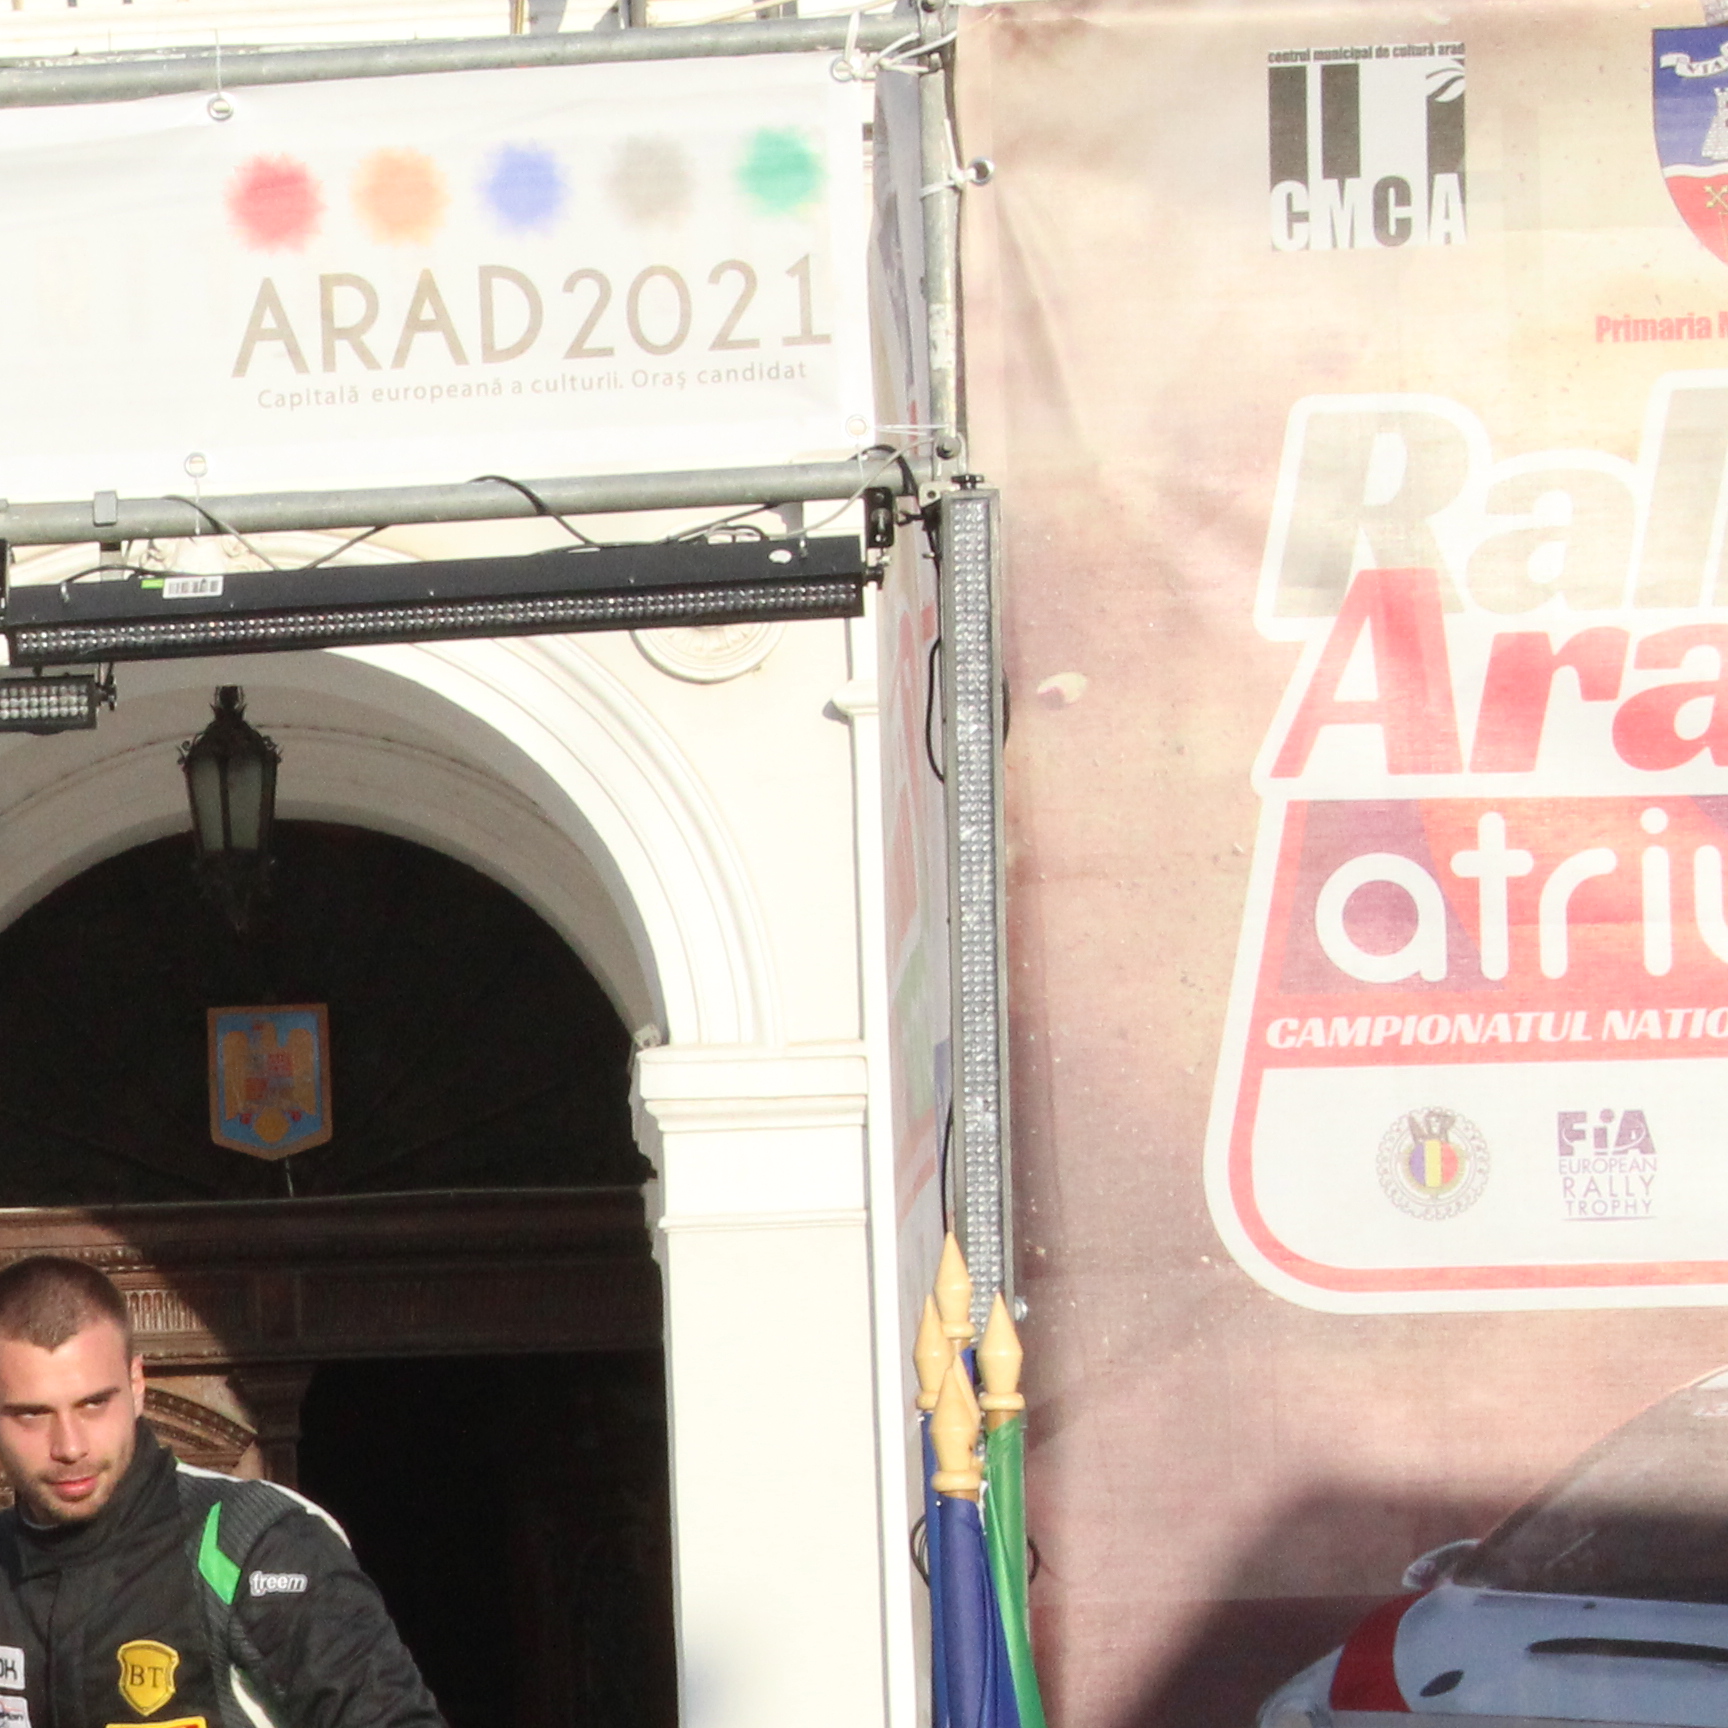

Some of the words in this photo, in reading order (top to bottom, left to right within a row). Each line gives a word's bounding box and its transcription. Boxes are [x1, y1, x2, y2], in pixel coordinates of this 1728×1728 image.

[1269, 173, 1467, 251] CMCA
[230, 252, 832, 379] ARAD2021
[1595, 312, 1712, 343] Primaria
[257, 383, 359, 410] Capitală
[509, 379, 523, 394] a
[697, 360, 808, 386] candidat
[1265, 1010, 1593, 1050] CAMPIONATUL
[1562, 1175, 1656, 1199] RALLY
[1565, 1199, 1653, 1217] TROPHY
[249, 1570, 308, 1597] freem
[129, 1664, 165, 1689] BT
